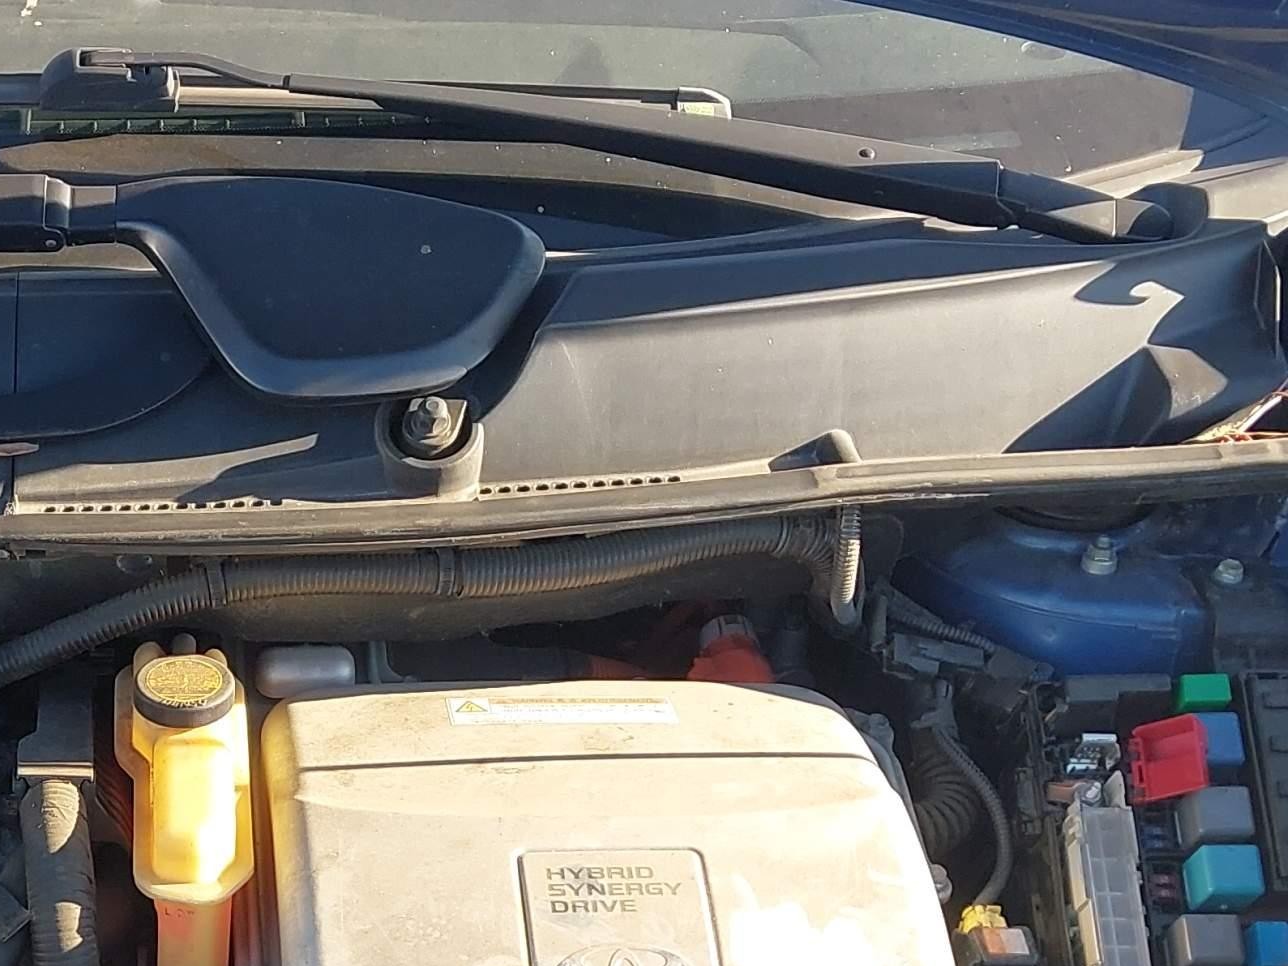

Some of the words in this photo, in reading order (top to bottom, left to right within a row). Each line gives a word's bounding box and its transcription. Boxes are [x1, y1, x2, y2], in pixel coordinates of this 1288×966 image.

[546, 866, 654, 880] HYBRID
[547, 882, 683, 897] SYNERGY
[550, 899, 638, 914] DRIVE
